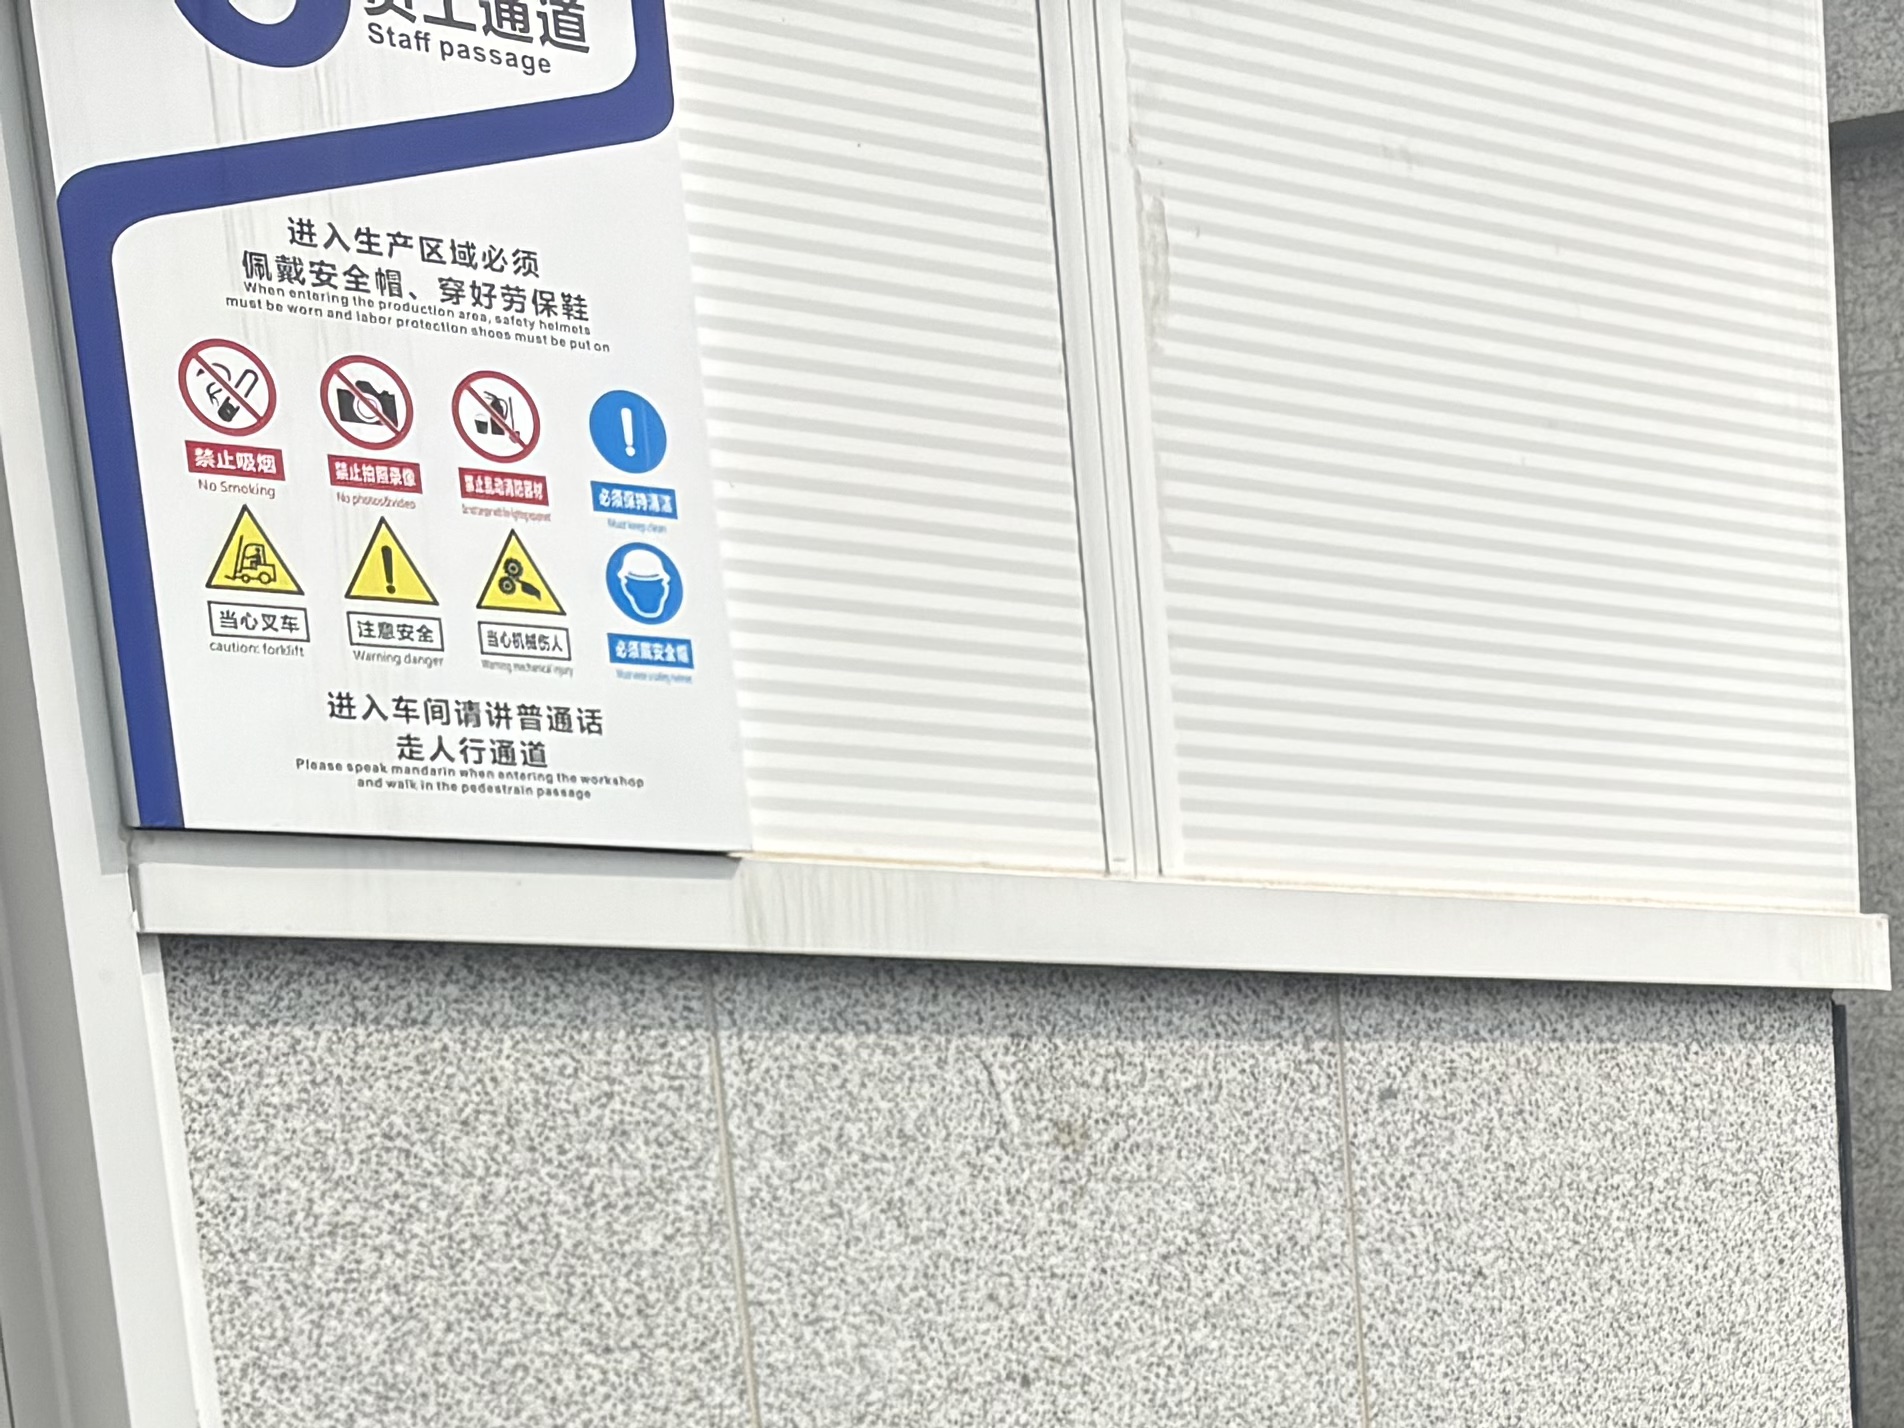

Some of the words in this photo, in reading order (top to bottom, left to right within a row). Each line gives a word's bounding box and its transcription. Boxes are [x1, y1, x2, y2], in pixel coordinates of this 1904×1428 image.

[367, 22, 431, 52] Staff
[440, 39, 552, 76] passage
[287, 216, 540, 279] 进入生产区域必须
[242, 249, 589, 322] 佩戴安全帽、穿好劳保鞋
[225, 296, 263, 310] must
[266, 299, 284, 312] be
[287, 304, 323, 318] worn
[327, 308, 352, 321] and
[356, 310, 392, 325] labor
[396, 317, 468, 335] protection
[471, 325, 511, 341] shoes
[515, 332, 547, 345] must
[551, 335, 566, 347] be
[570, 338, 591, 351] put
[593, 342, 610, 353] on
[243, 281, 286, 298] When
[289, 288, 349, 307] entering
[352, 295, 375, 308] the
[379, 299, 455, 318] production
[495, 314, 536, 331] safety
[539, 318, 591, 336] helmets
[194, 447, 277, 475] 禁止吸烟
[198, 479, 217, 493] No
[220, 480, 276, 500] Smoking
[219, 609, 300, 634] 当心叉车
[356, 620, 434, 643] 注意安全
[352, 649, 402, 667] Warning
[404, 653, 444, 669] danger
[327, 691, 604, 736] 进入车间请讲普通话
[396, 732, 548, 768] 走人行通道
[295, 757, 343, 772] Please
[346, 761, 388, 775] speak
[391, 763, 456, 777] mandarin
[459, 767, 495, 779] when
[499, 770, 554, 785] entering
[557, 771, 577, 784] the
[580, 774, 645, 789] workshop
[357, 777, 383, 789] and
[386, 778, 418, 791] walk
[420, 779, 433, 791] in
[436, 779, 458, 793] the
[536, 786, 592, 800] passage
